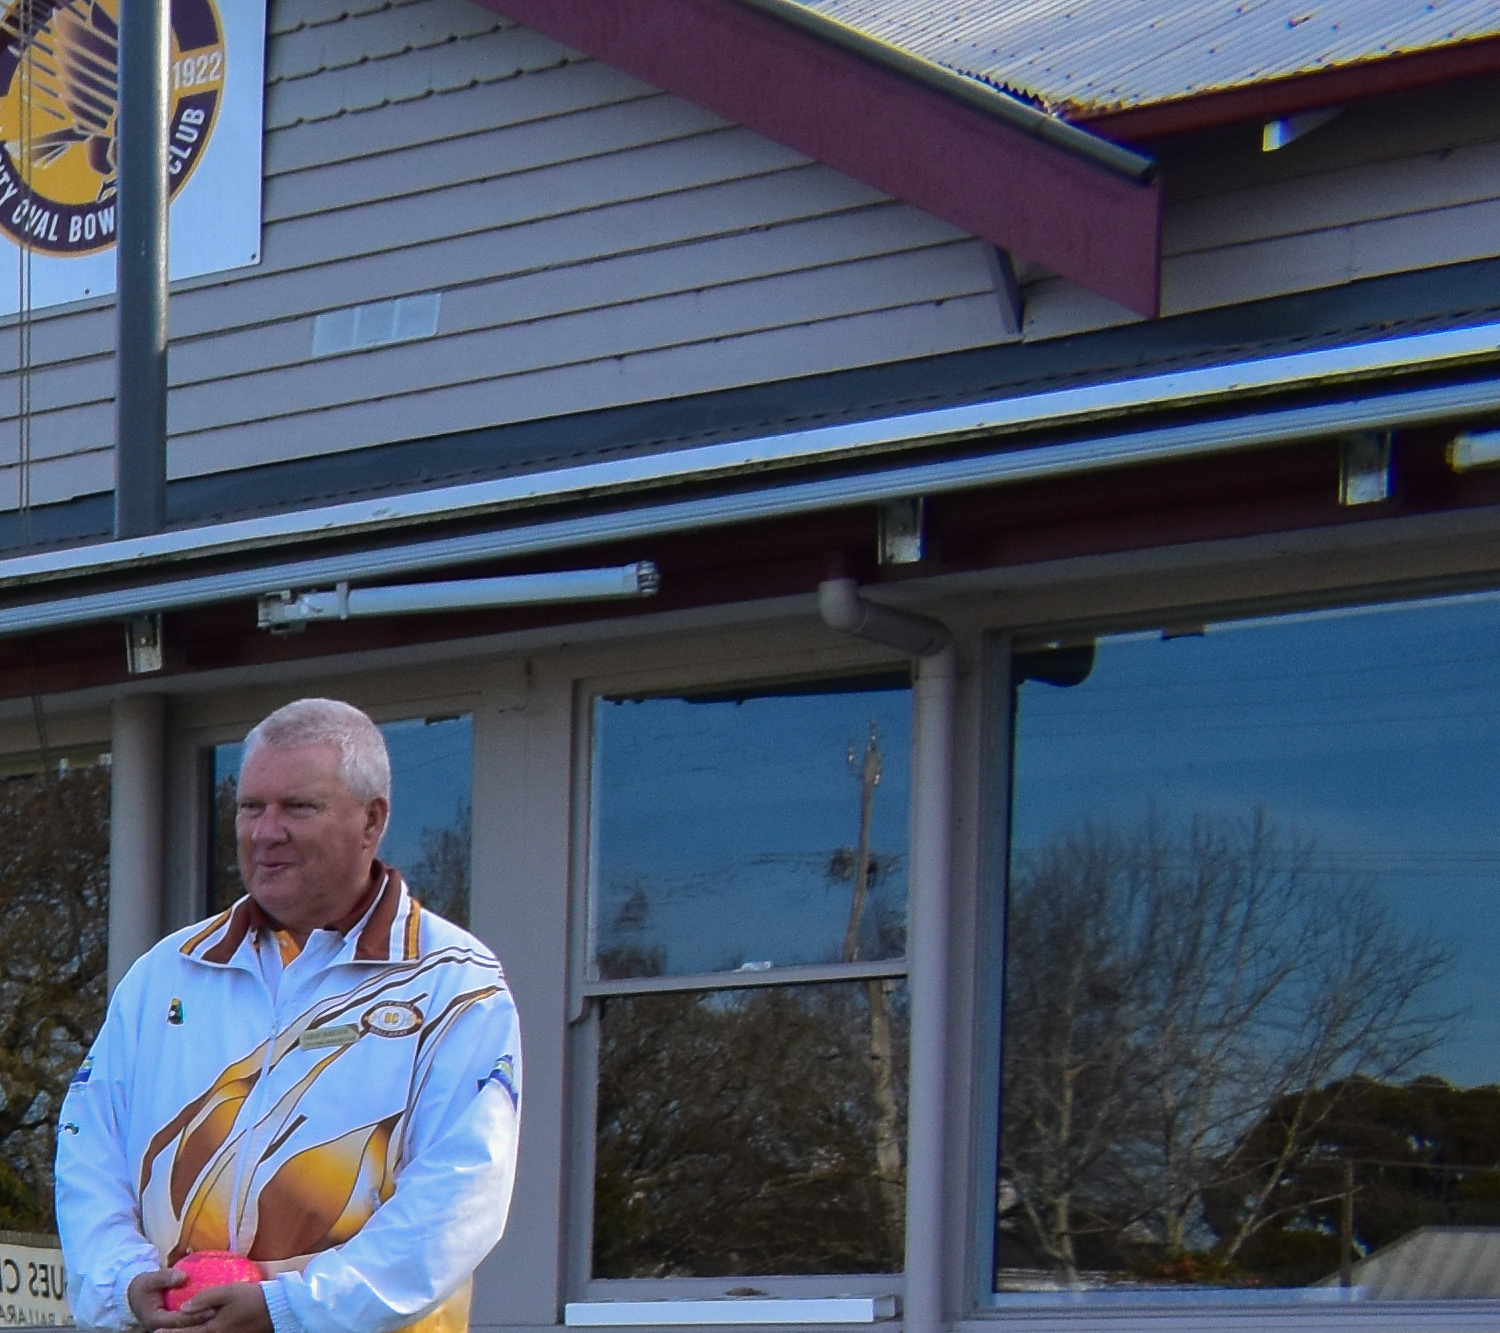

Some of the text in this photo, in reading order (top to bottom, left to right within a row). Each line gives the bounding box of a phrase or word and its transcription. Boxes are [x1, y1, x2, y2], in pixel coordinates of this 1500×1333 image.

[174, 52, 222, 90] 1922
[12, 199, 59, 242] OVAL
[168, 108, 205, 174] CLUB
